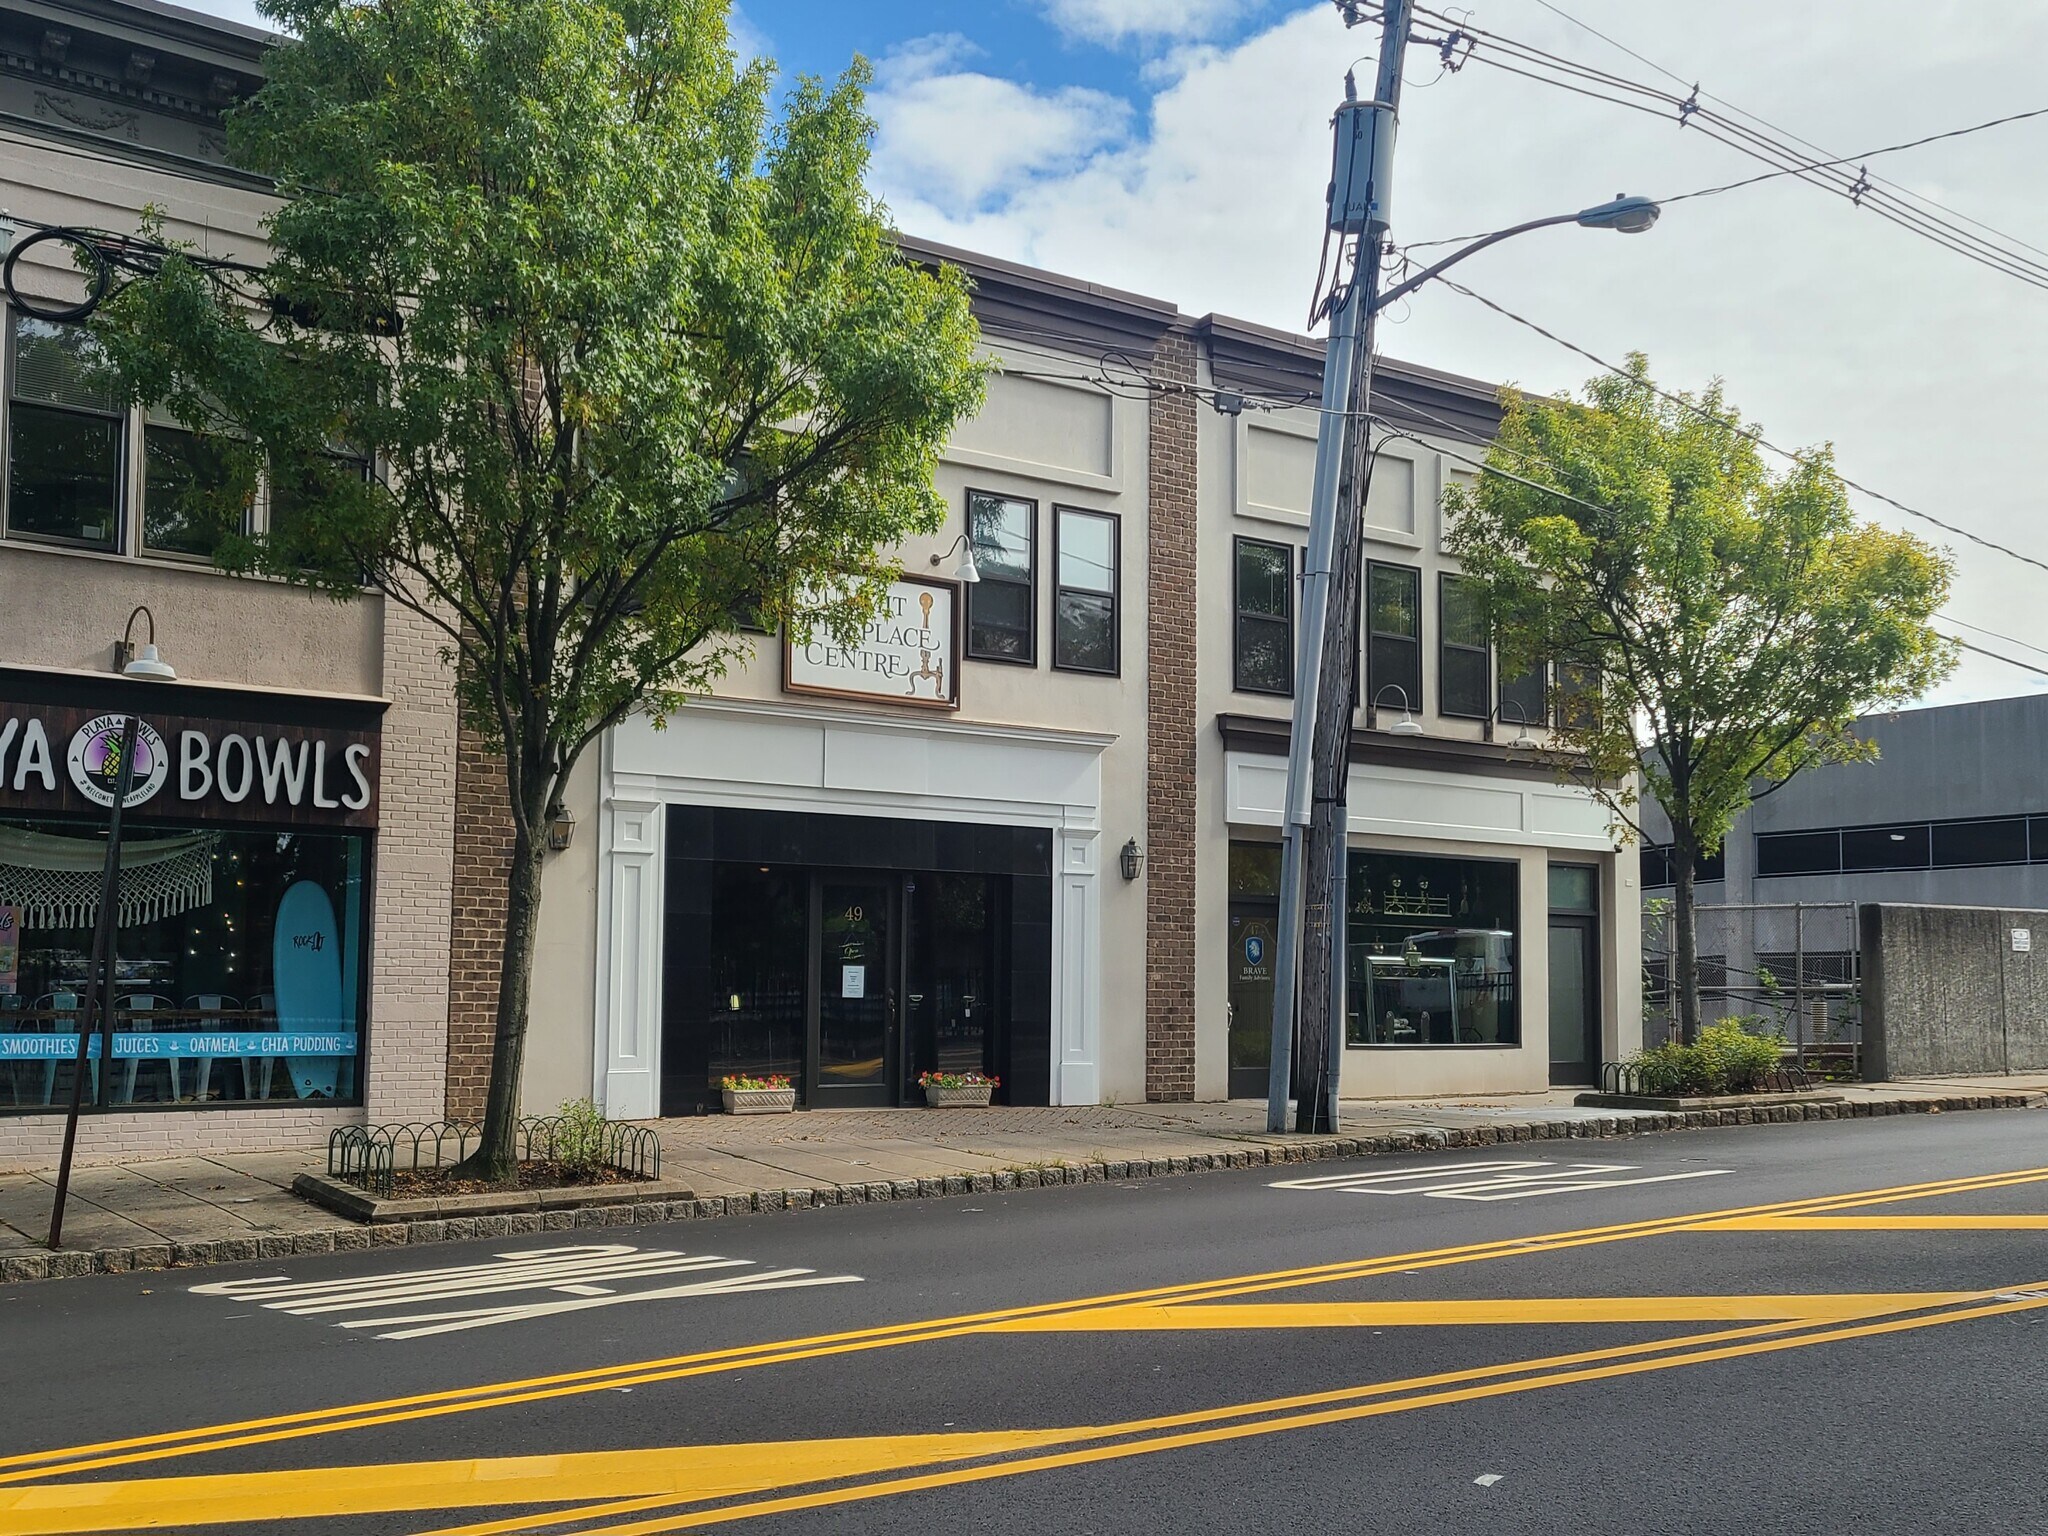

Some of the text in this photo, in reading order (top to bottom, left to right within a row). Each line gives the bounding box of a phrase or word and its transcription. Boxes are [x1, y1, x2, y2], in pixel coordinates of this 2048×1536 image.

[805, 641, 910, 679] CENTRE
[81, 716, 115, 738] PLAYA
[180, 730, 371, 810] BOWLS
[844, 906, 863, 921] 49
[1243, 967, 1268, 975] BRAVE
[2, 1036, 341, 1055] SMOOTHIES JUICES OATMEAL CHIA PUDDING
